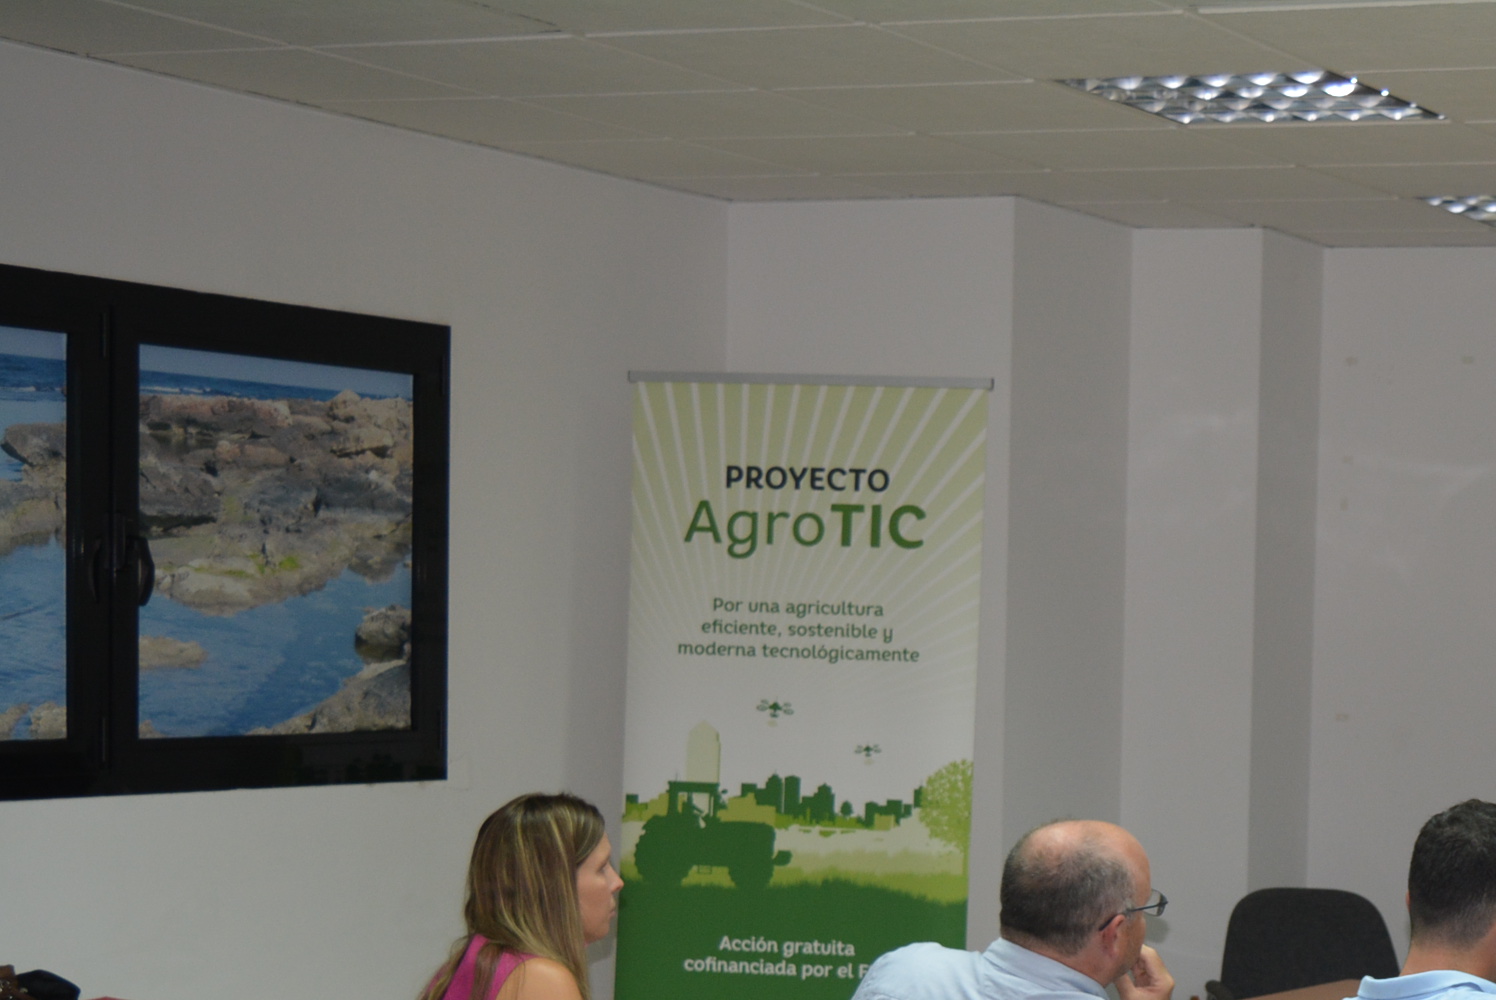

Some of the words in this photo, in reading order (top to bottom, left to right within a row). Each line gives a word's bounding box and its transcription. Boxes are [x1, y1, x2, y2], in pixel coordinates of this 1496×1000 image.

[725, 465, 890, 492] PROYECTO
[684, 499, 927, 559] AgroTIC
[713, 598, 742, 613] Por
[748, 602, 780, 614] una
[786, 599, 884, 618] agricultura
[701, 620, 782, 638] eficiente,
[788, 623, 878, 640] sostenible
[882, 628, 893, 643] y
[677, 641, 756, 658] moderna
[762, 643, 920, 664] tecnológicamente
[719, 935, 778, 954] Acción
[783, 939, 855, 957] gratuita
[684, 957, 797, 977] cofinanciada
[801, 964, 833, 980] por
[837, 962, 854, 979] el
